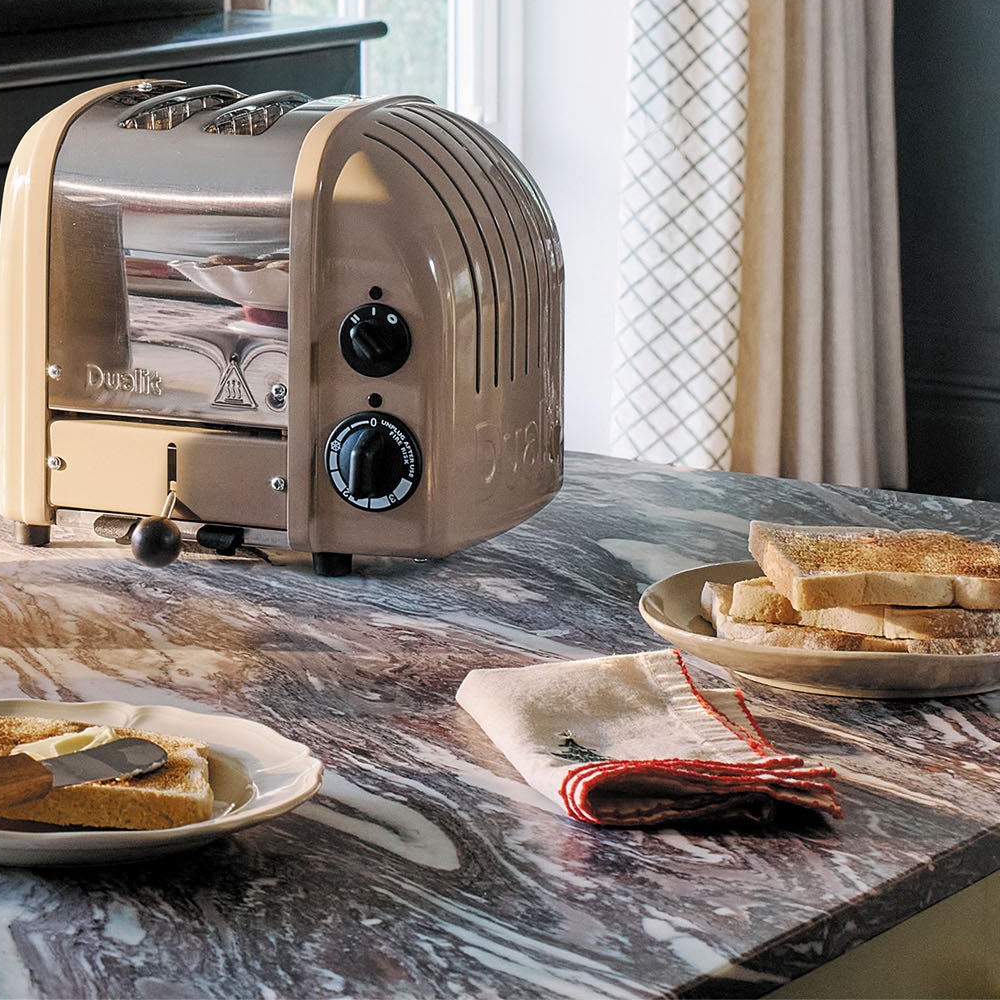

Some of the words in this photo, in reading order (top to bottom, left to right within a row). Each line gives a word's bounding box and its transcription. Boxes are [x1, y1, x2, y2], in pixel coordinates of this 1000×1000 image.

[86, 363, 163, 396] Dualit
[381, 419, 406, 441] UNPLUG
[403, 441, 415, 464] AFTER
[388, 430, 403, 446] FIRE
[400, 447, 409, 465] RISK
